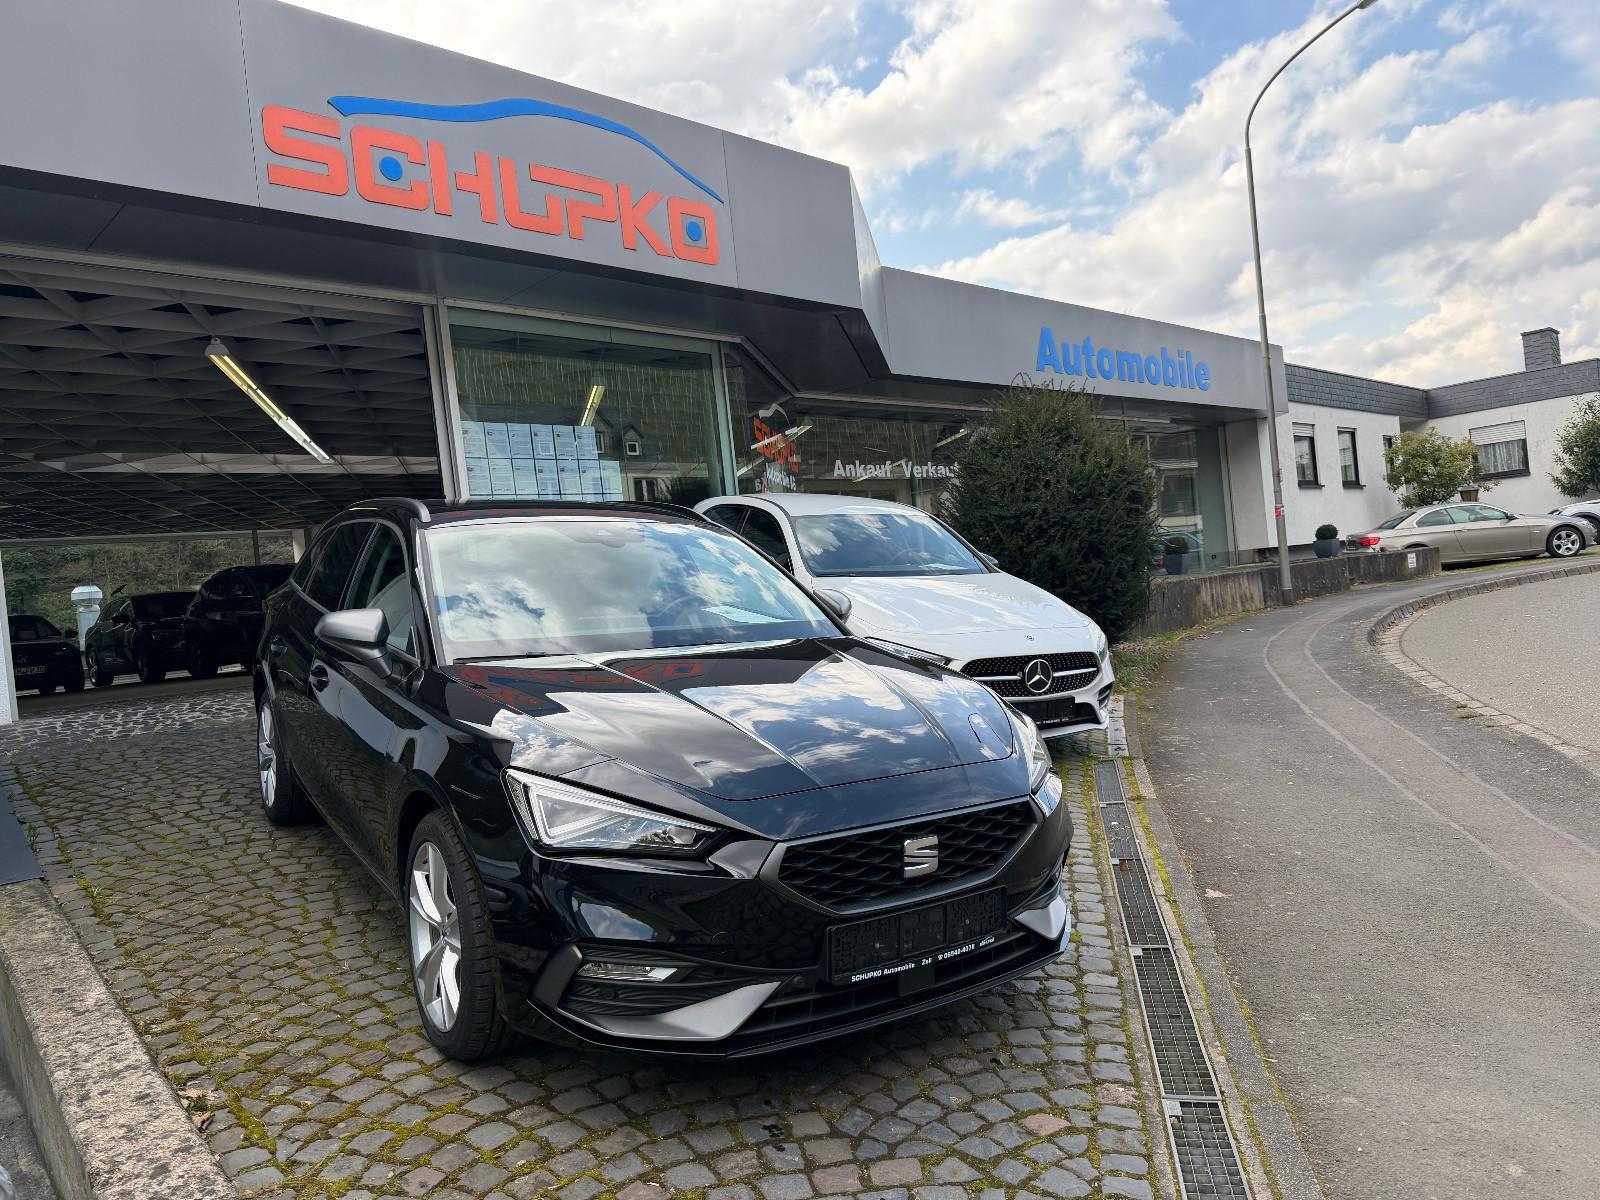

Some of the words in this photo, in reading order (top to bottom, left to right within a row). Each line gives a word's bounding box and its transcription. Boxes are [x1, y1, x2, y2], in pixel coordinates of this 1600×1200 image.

[262, 104, 720, 266] SCHUPKO
[1036, 326, 1212, 391] Automobile
[833, 459, 893, 478] Ankauf
[851, 969, 882, 982] SCHUPKO
[883, 962, 915, 975] Automobile
